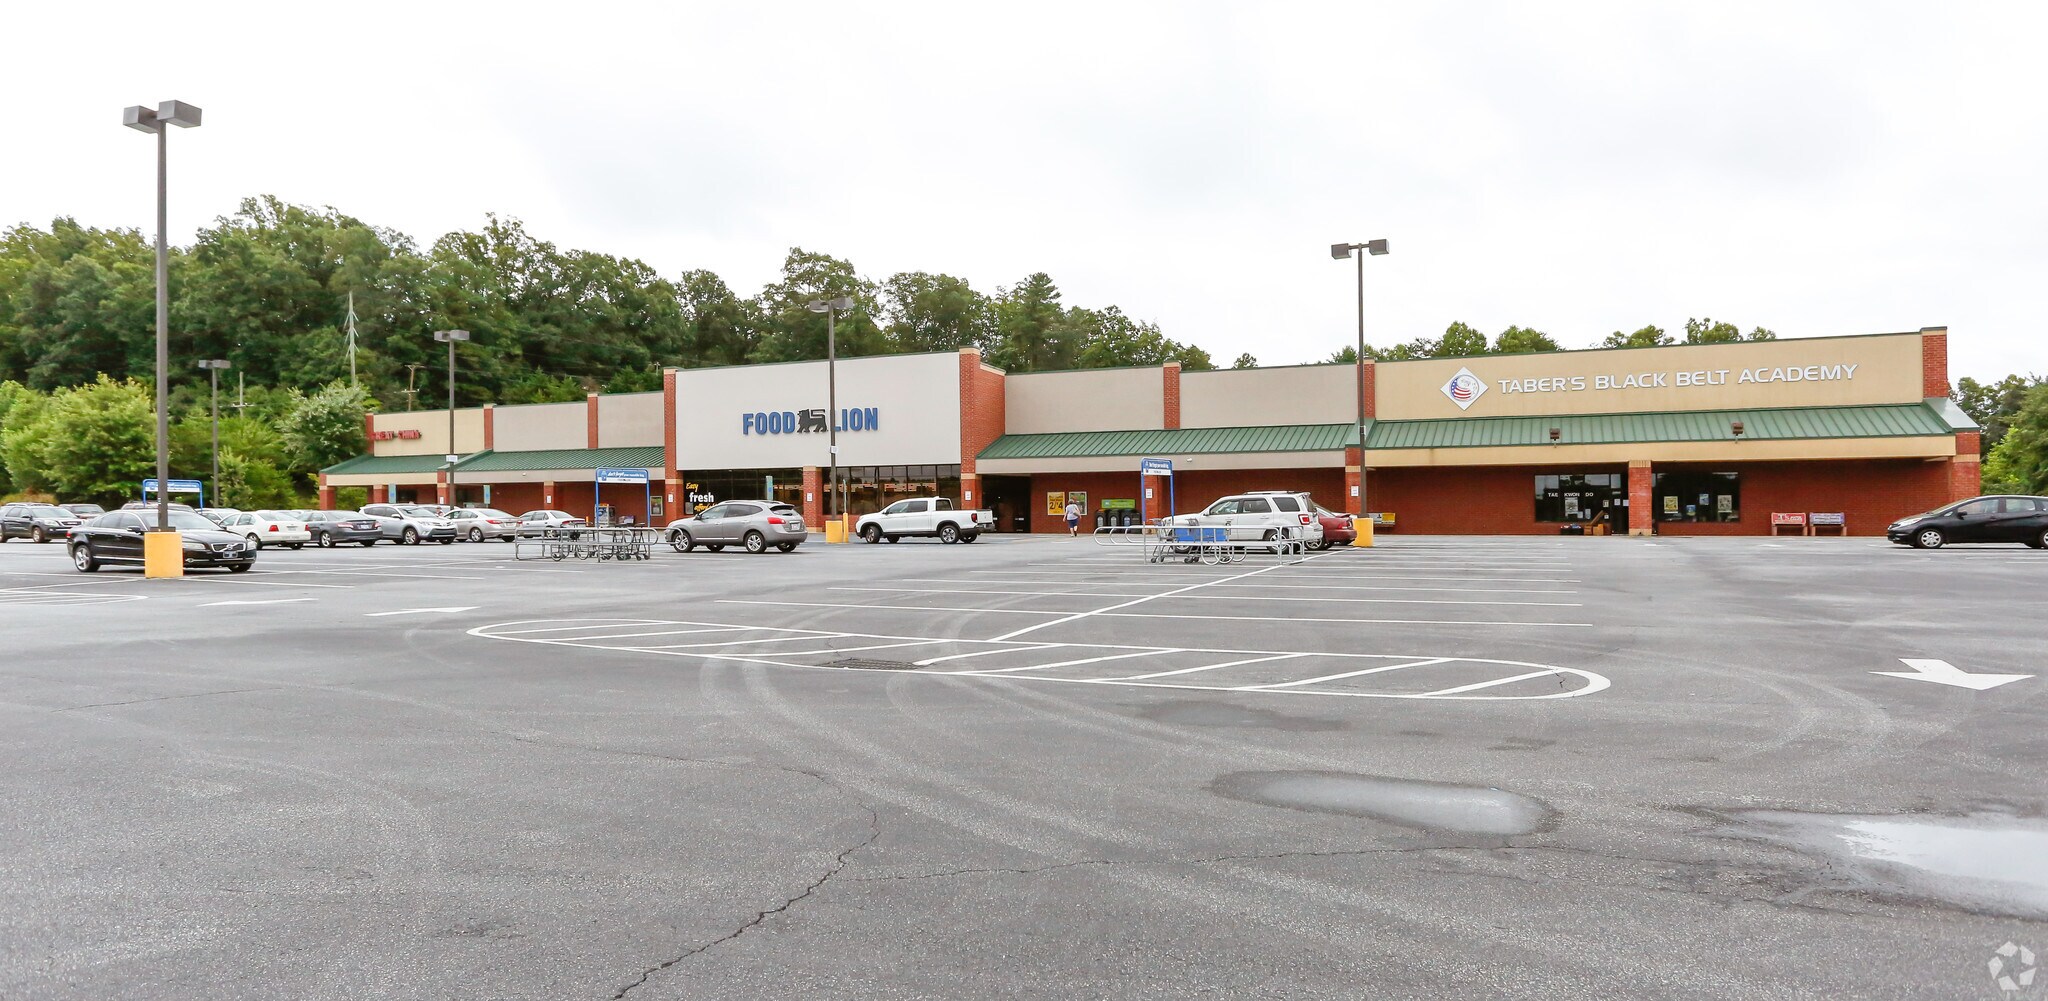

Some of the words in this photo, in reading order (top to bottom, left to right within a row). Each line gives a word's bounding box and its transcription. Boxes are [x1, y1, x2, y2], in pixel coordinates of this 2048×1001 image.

[1498, 376, 1586, 394] TABER'S
[1595, 372, 1668, 390] BLACK
[1675, 369, 1730, 387] BELT
[1737, 364, 1859, 384] ACADEMY
[742, 411, 796, 435] FOOD
[685, 482, 699, 492] Easy
[689, 492, 714, 502] fresh
